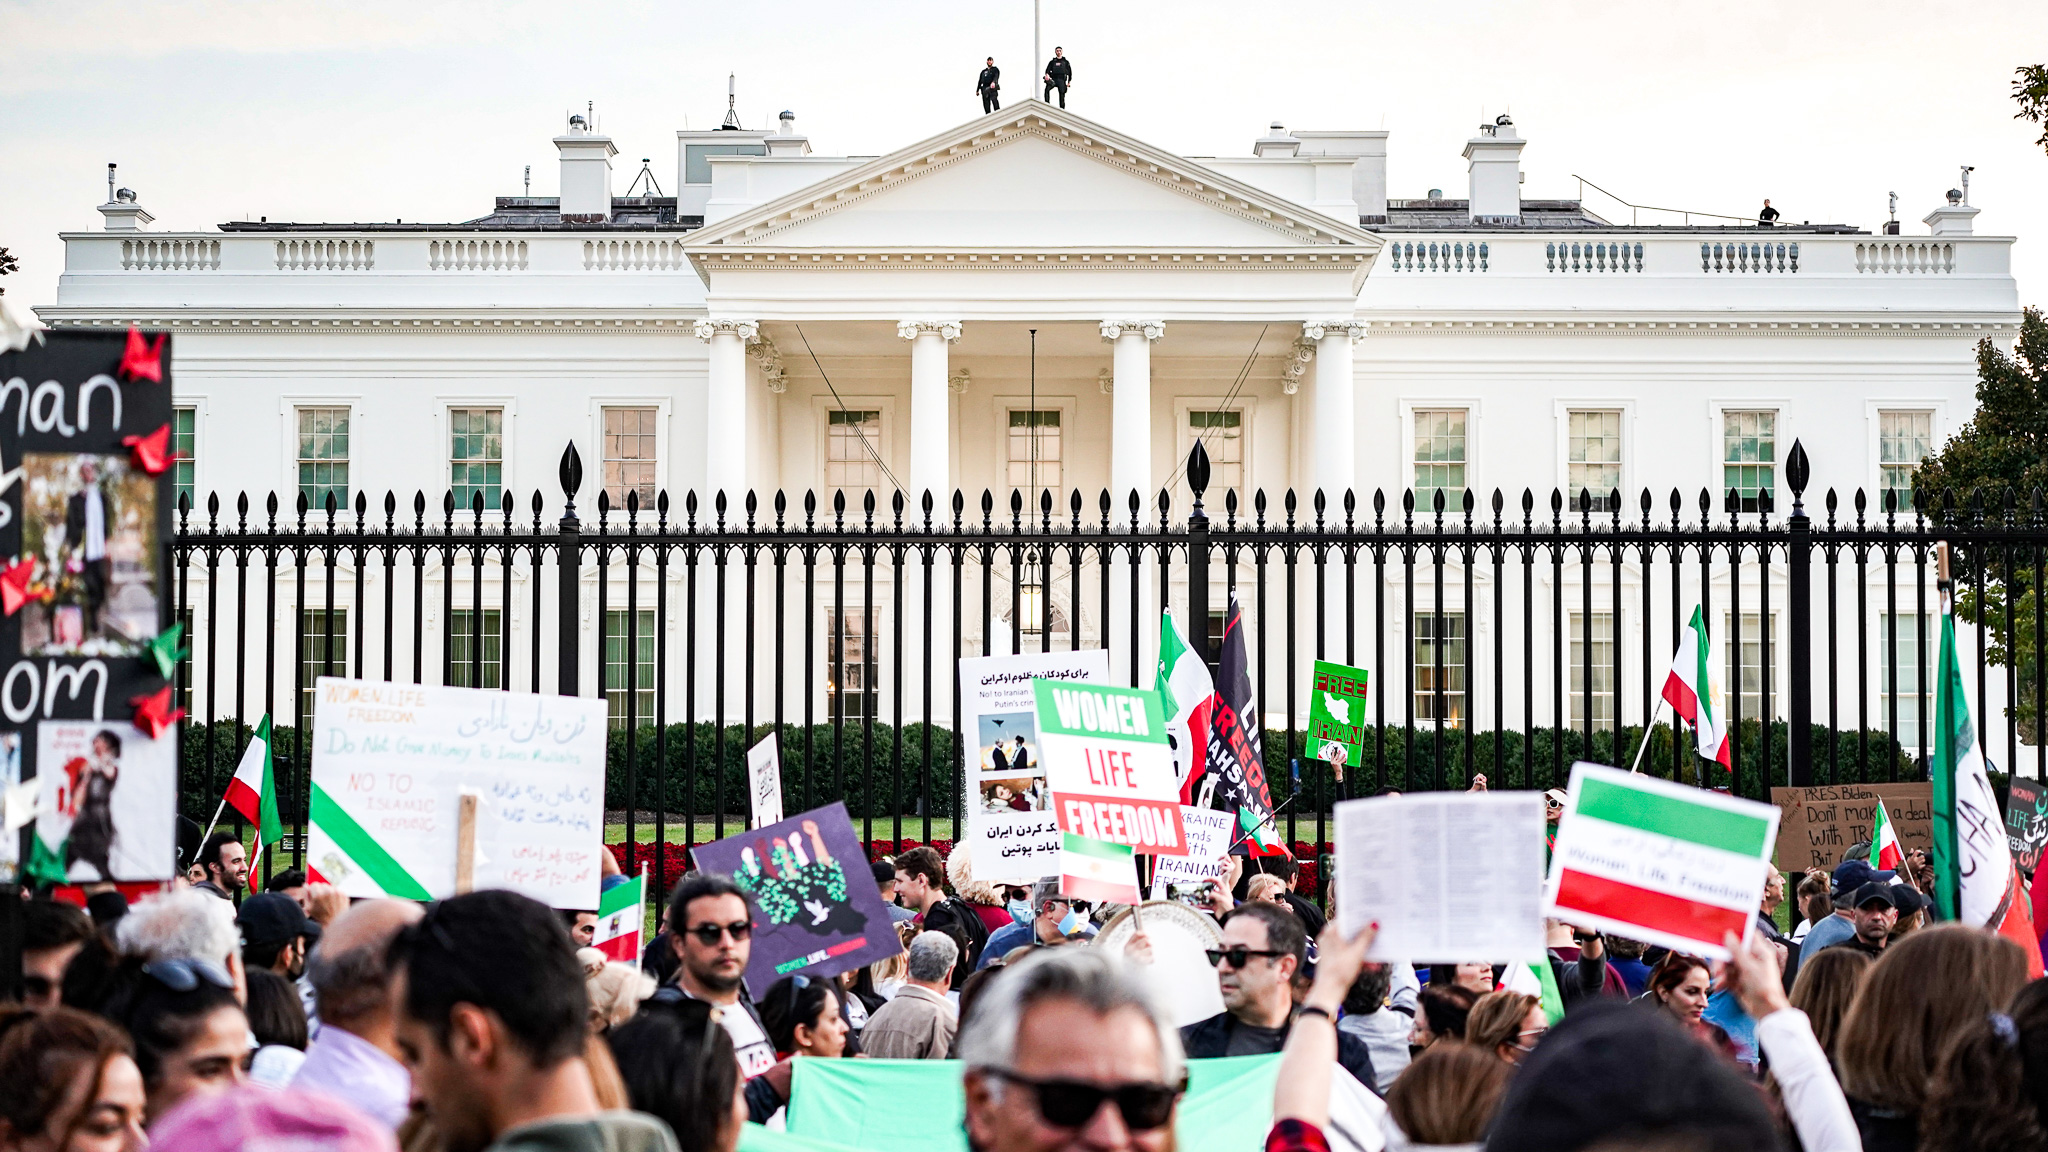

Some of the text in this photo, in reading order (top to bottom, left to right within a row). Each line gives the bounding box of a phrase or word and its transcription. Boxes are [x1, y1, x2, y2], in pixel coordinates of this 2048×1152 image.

[1040, 669, 1070, 681] کودکان
[1069, 668, 1089, 680] برای
[994, 690, 1003, 698] to
[1003, 688, 1029, 697] Iranian
[1313, 671, 1367, 699] FREE
[1052, 687, 1149, 737] WOMEN
[325, 727, 355, 755] Do
[1313, 719, 1362, 746] IRAN
[1085, 748, 1137, 788] LIFE
[347, 772, 413, 794] NO TO
[1803, 787, 1840, 801] PRES.
[2010, 785, 2036, 803] WOMAN
[367, 797, 435, 813] ISLAMIC
[1844, 805, 1876, 821] mak
[1893, 807, 1903, 820] a
[1904, 799, 1932, 821] deal
[1064, 800, 1178, 848] FREEDOM
[1180, 812, 1228, 830] KRAINE
[2007, 808, 2030, 831] LIFE
[987, 825, 1013, 839] ایران
[1016, 823, 1043, 837] کردن
[1184, 830, 1212, 843] ands
[1808, 825, 1844, 846] With
[1001, 843, 1032, 858] پوتین
[1187, 841, 1208, 857] ith
[2006, 833, 2032, 853] FREEDOM
[1159, 857, 1221, 877] IRANIAN
[1810, 850, 1833, 868] But
